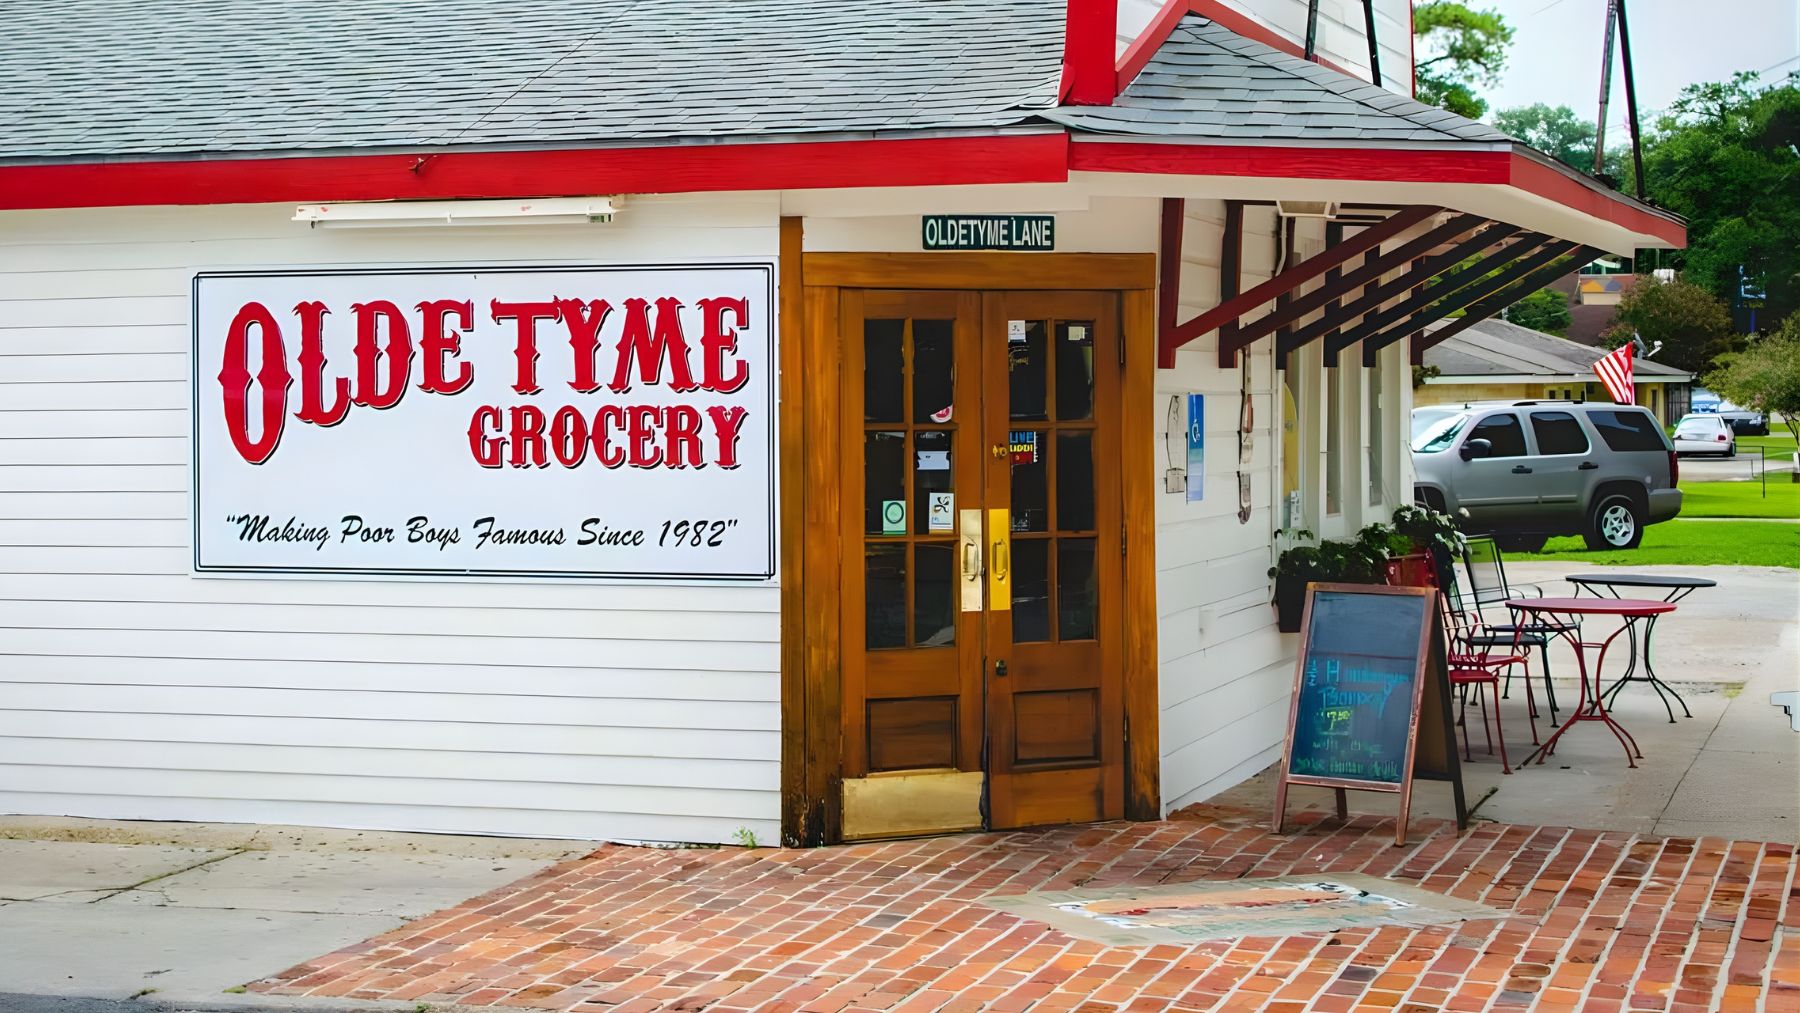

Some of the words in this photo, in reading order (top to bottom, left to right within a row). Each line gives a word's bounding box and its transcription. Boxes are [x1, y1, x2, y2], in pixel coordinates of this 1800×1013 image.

[925, 218, 1009, 246] OLDETYME
[1011, 218, 1052, 246] LANE
[217, 298, 476, 466] OLDE
[489, 294, 751, 396] TYME
[467, 404, 750, 471] GROCERY
[226, 513, 331, 552] "Making
[340, 514, 395, 544] Poor
[405, 515, 462, 552] Boys
[472, 516, 567, 550] Famous
[576, 517, 645, 547] Since
[658, 517, 739, 549] 1982"
